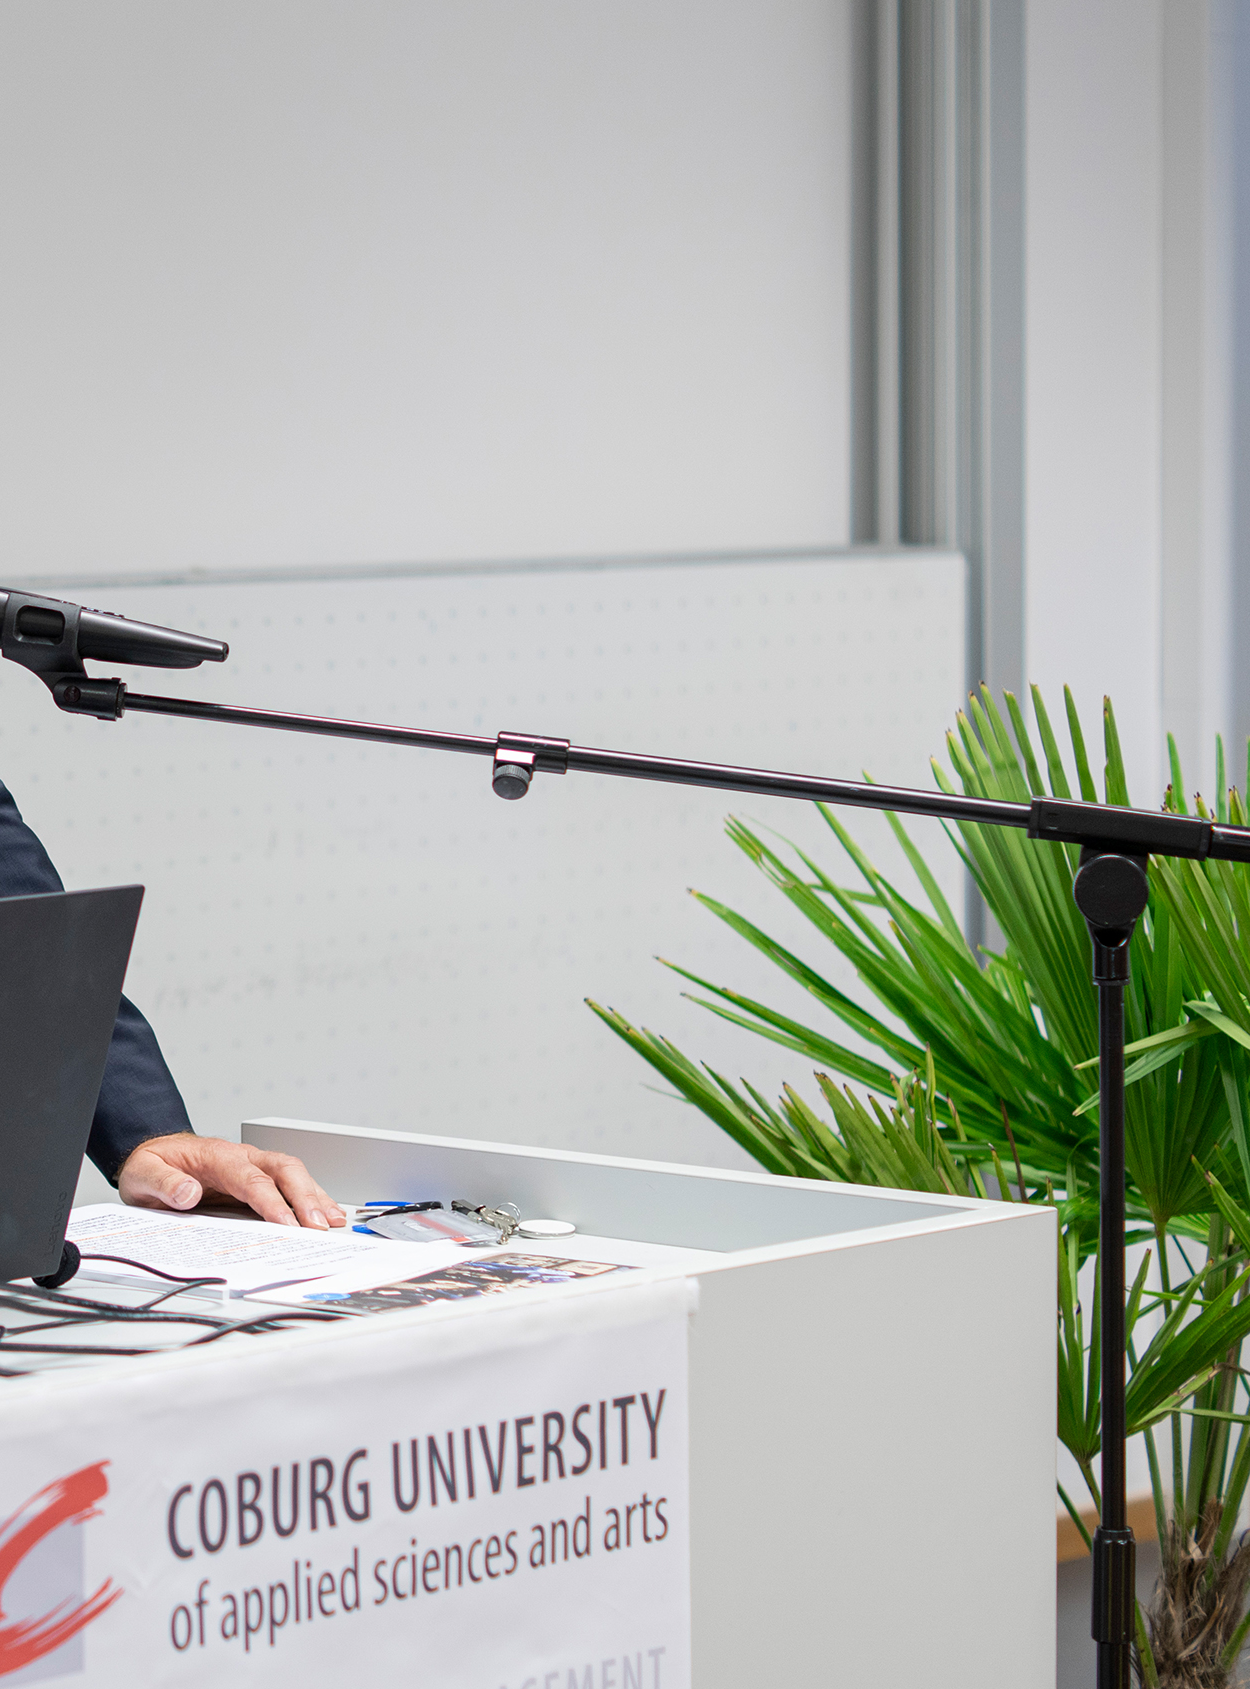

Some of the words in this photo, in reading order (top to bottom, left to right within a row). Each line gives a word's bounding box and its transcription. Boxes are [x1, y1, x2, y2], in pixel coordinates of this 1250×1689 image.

[166, 1447, 371, 1561] COBURG
[391, 1387, 667, 1514] UNIVERSITY
[170, 1579, 210, 1652] of
[220, 1546, 361, 1652] applied
[373, 1534, 519, 1607] sciences
[528, 1495, 592, 1570] and
[602, 1490, 669, 1553] arts
